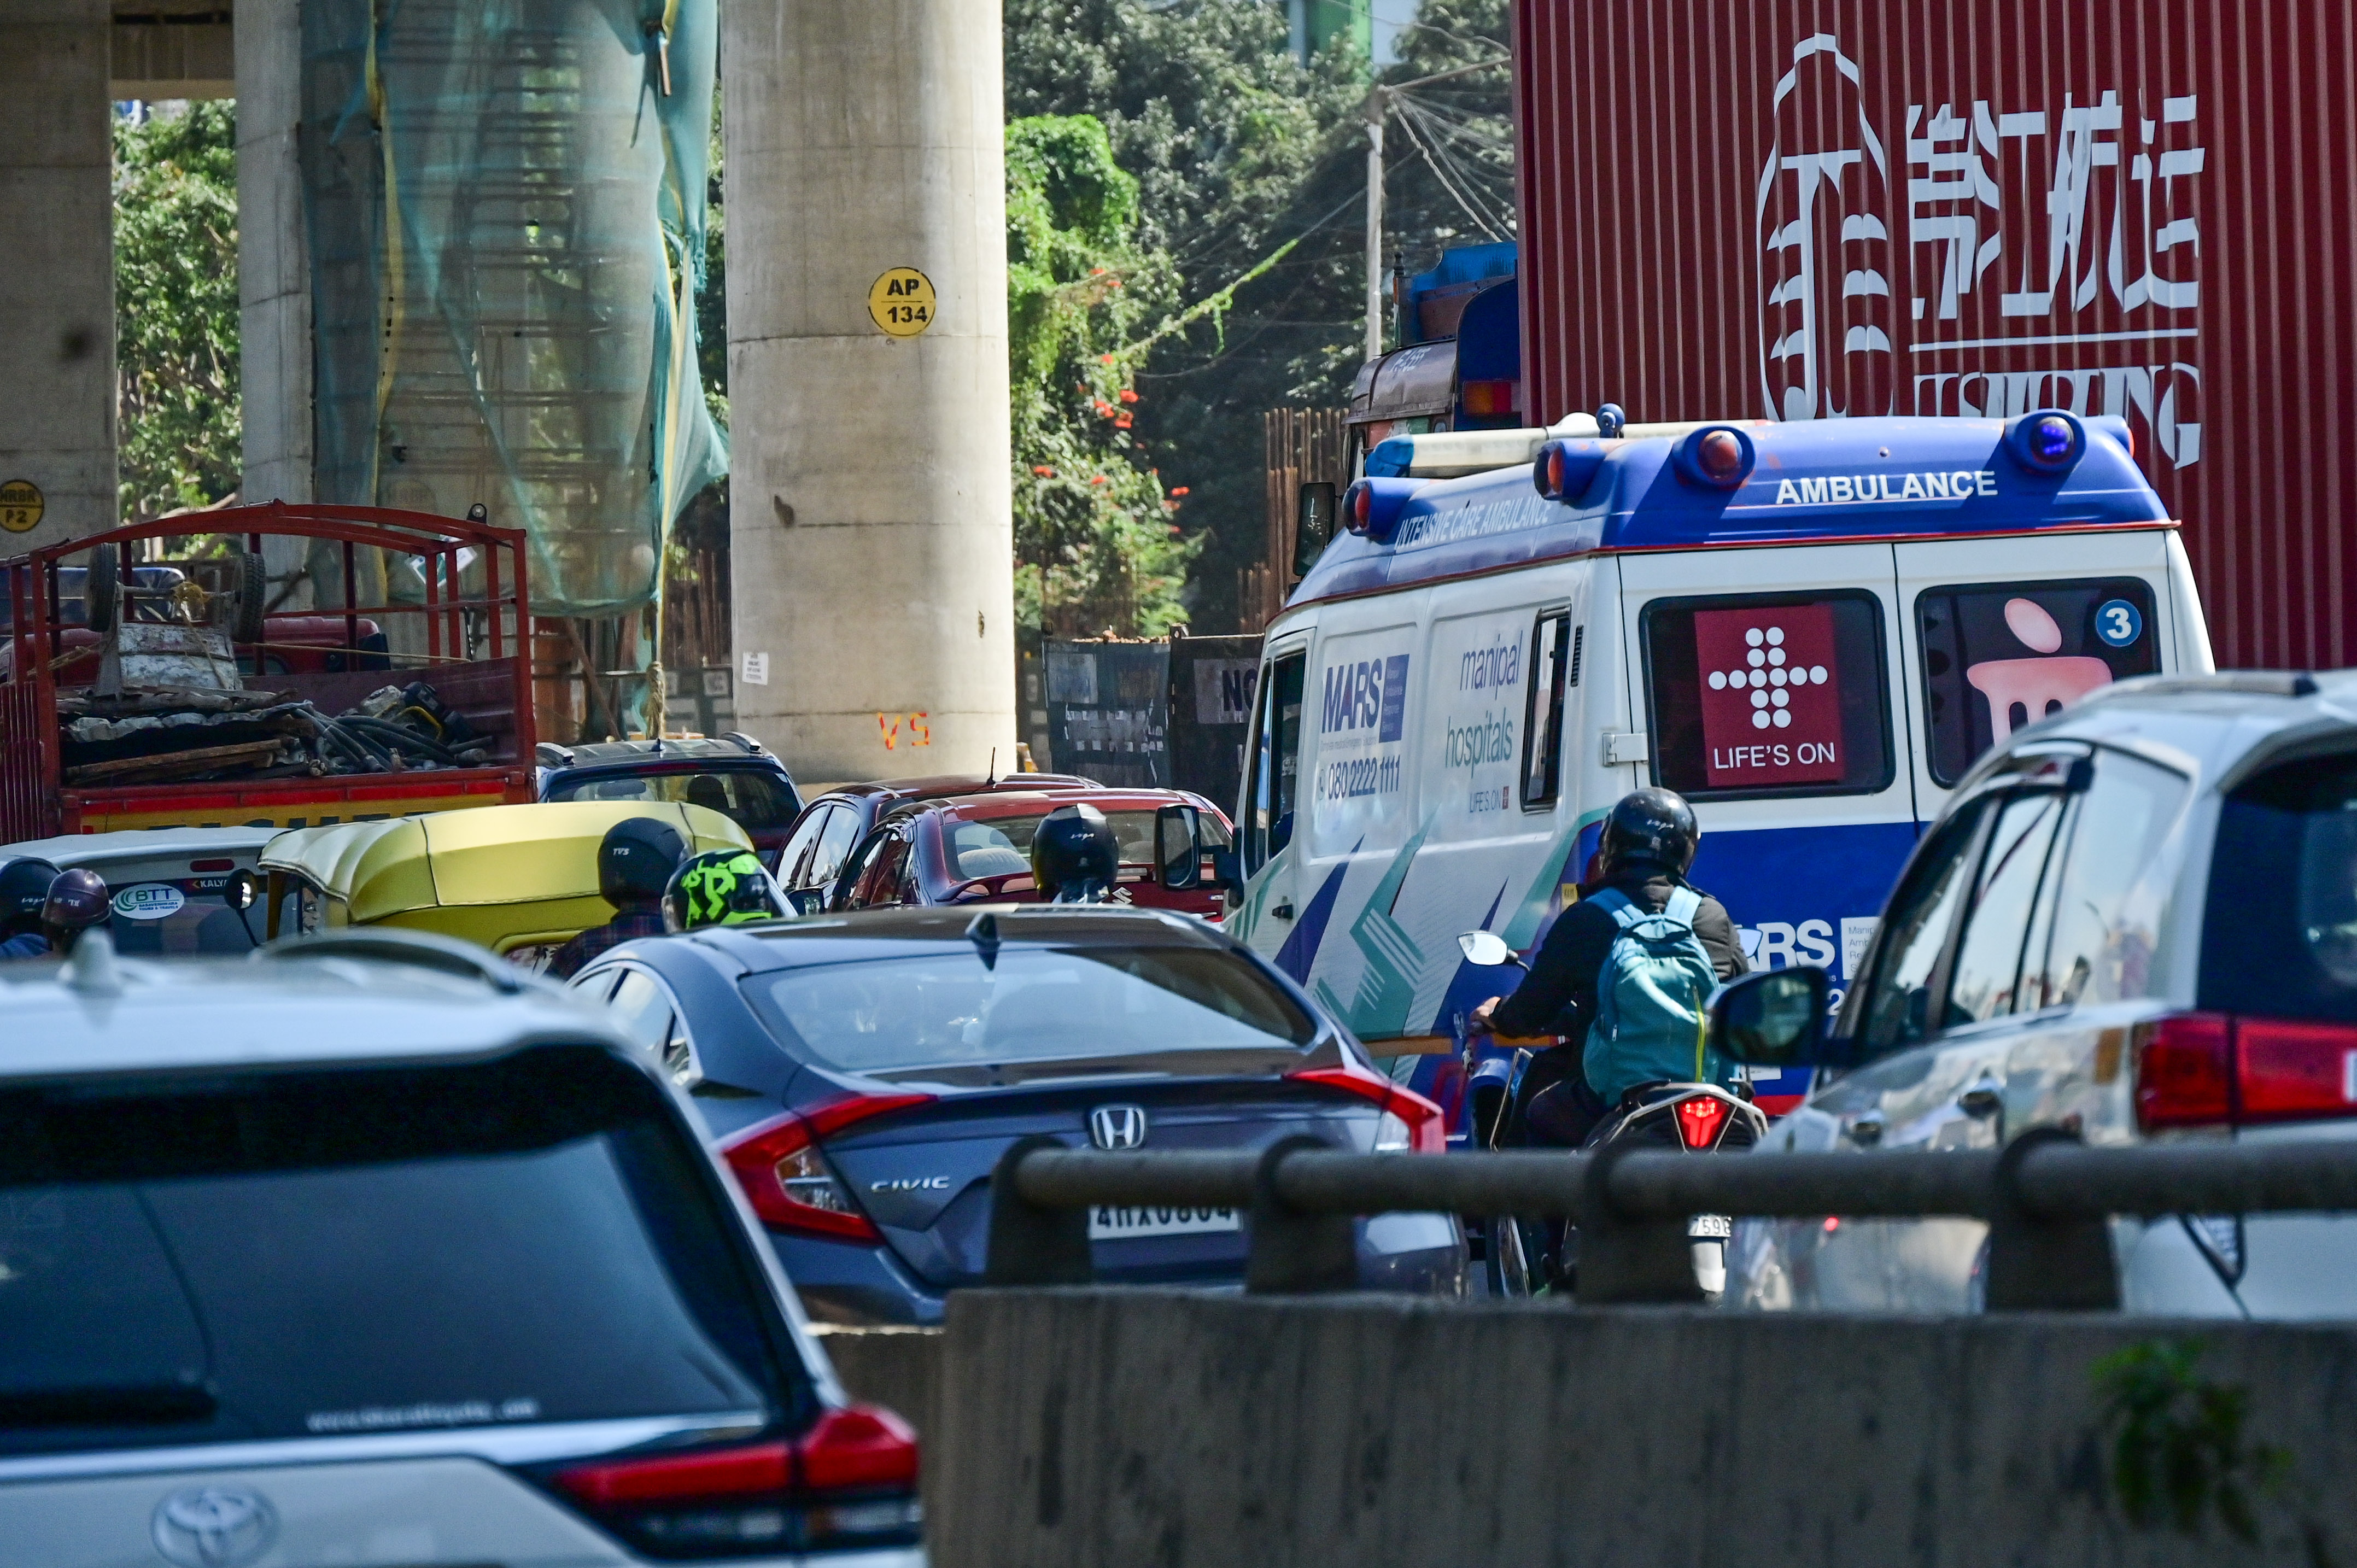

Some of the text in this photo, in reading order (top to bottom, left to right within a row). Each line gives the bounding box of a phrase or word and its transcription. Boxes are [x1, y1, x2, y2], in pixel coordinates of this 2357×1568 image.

[887, 279, 919, 296] AP
[887, 306, 927, 323] 134
[1776, 471, 1998, 504] AMBULANCE
[1395, 495, 1551, 549] INTENSIVE CARE AMBULANCE
[2105, 608, 2132, 640] 3
[1460, 630, 1523, 700] manipal
[1322, 658, 1382, 733] MARS
[1446, 707, 1513, 779] hospitals
[1714, 742, 1835, 769] LIFE'S ON
[1329, 754, 1400, 800] 080 2222 1111
[135, 888, 172, 901] BTT
[871, 1175, 950, 1191] CIVIC
